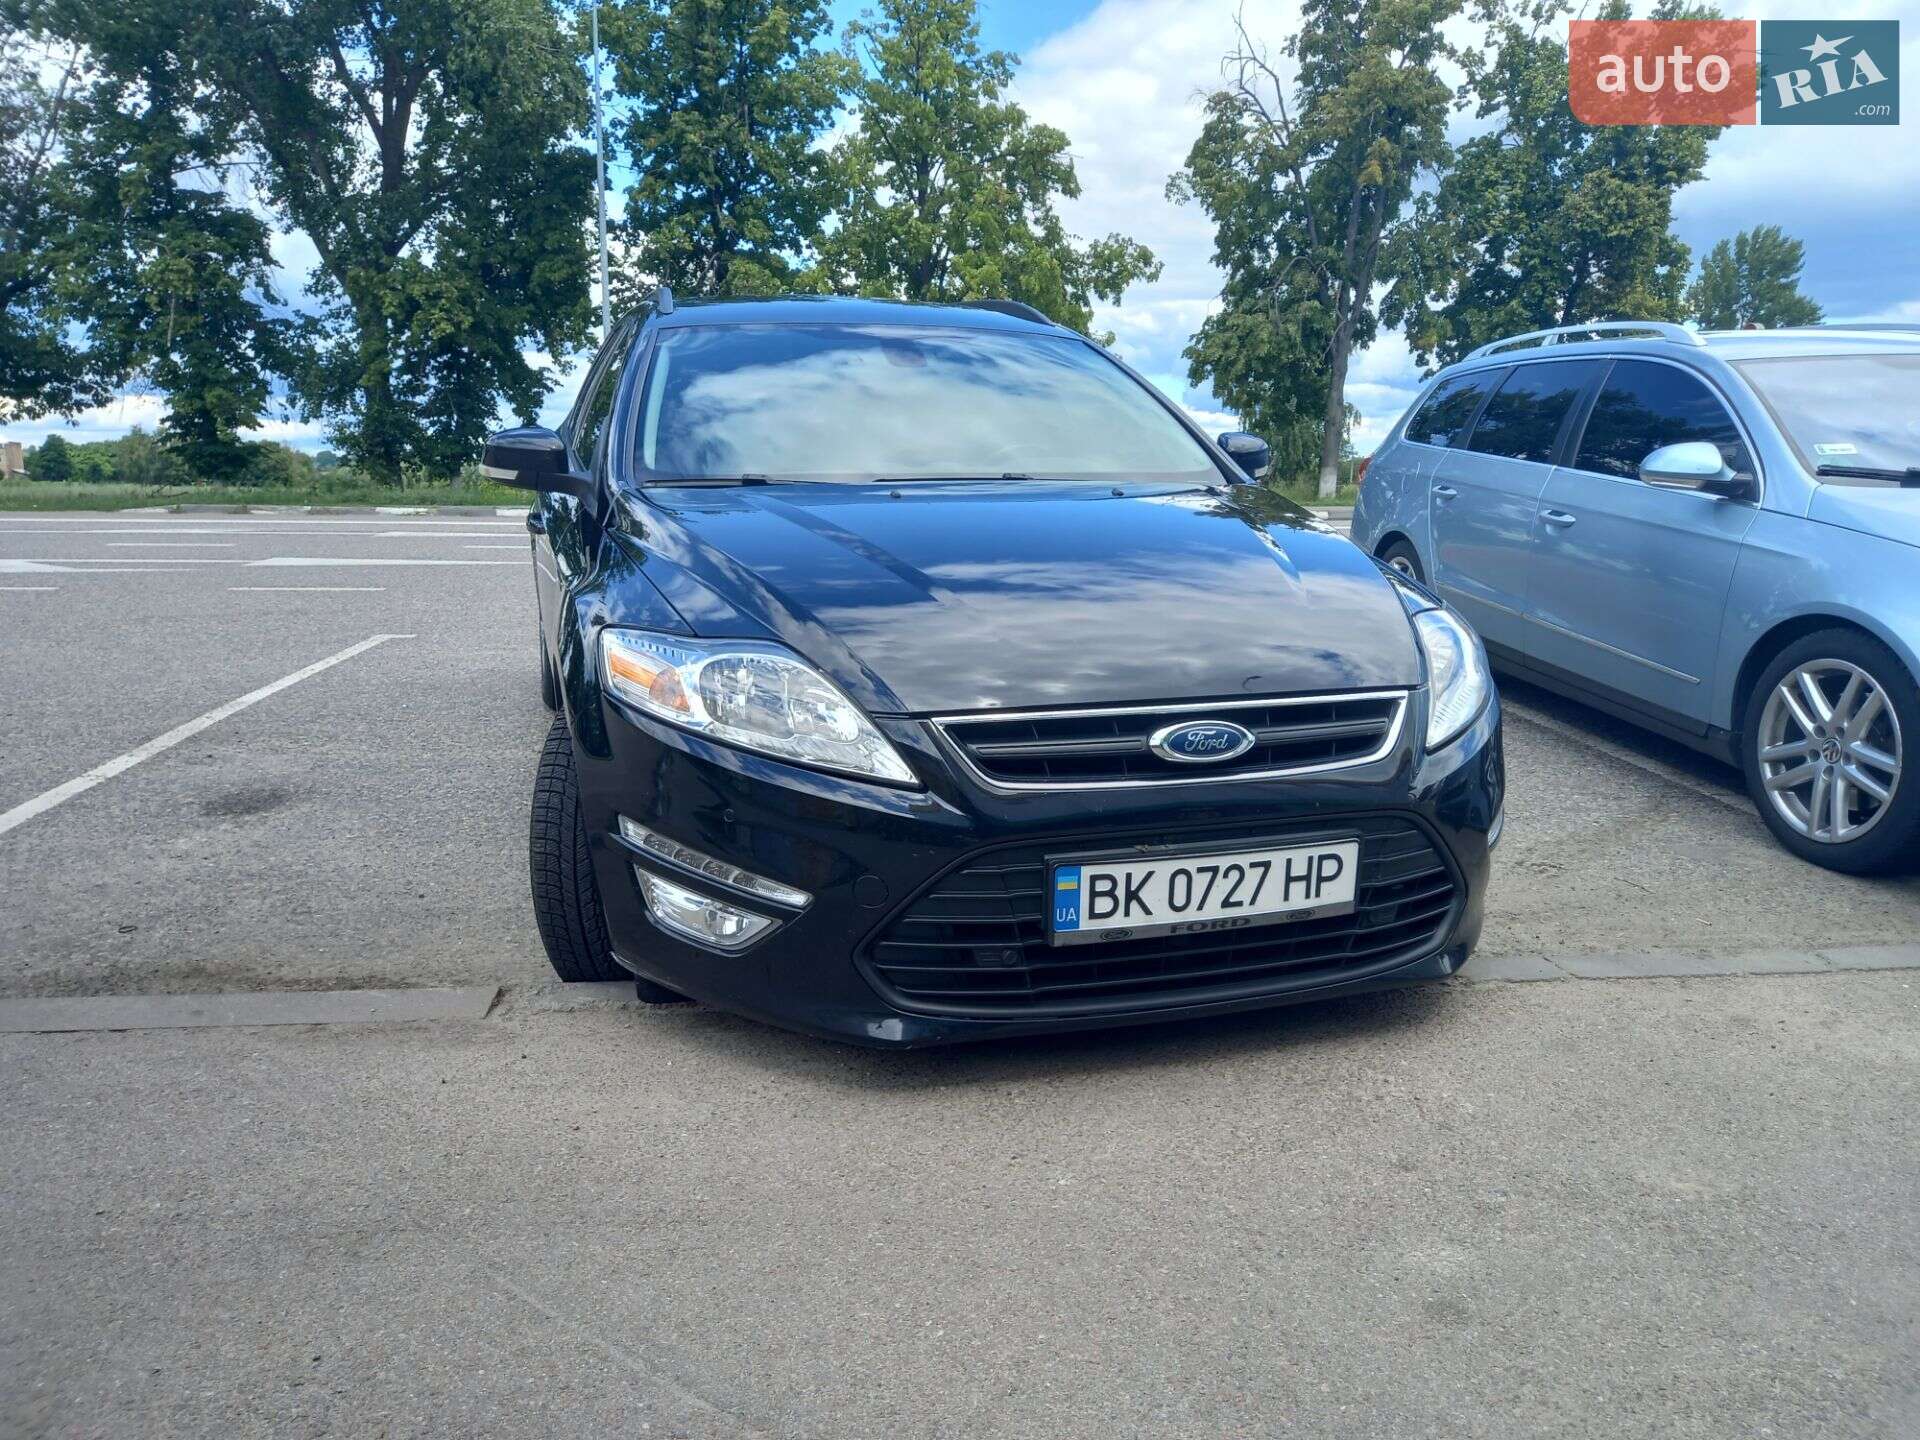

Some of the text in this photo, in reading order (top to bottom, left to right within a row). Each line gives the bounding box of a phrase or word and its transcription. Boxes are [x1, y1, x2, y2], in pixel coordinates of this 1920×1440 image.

[1184, 730, 1228, 752] Ford
[1088, 853, 1344, 920] BK 0727 HP
[1056, 907, 1077, 922] UA
[1169, 917, 1251, 934] FORD
